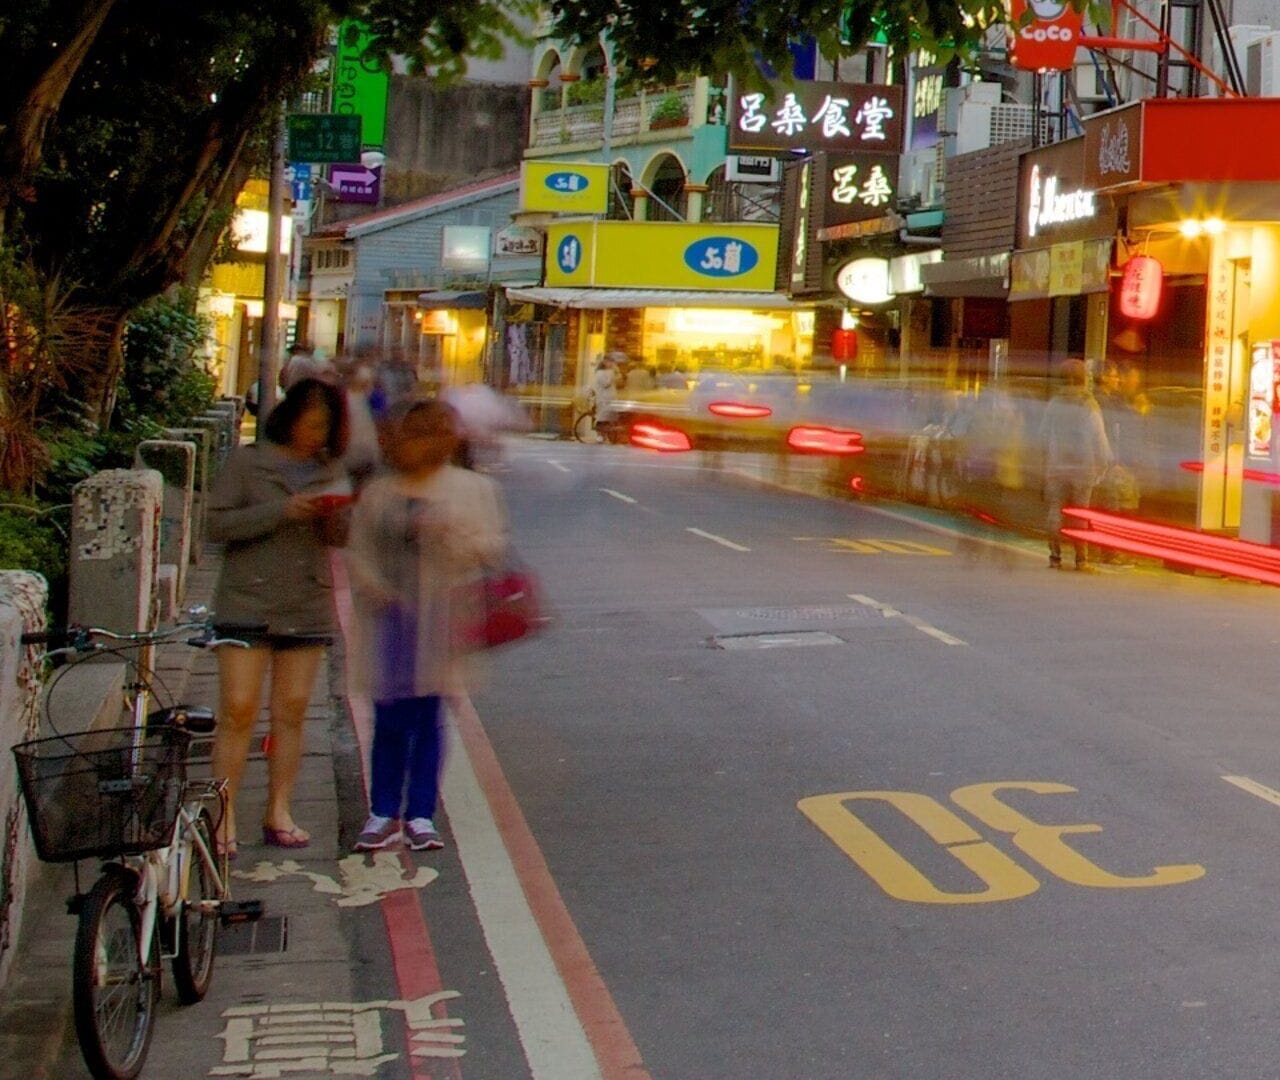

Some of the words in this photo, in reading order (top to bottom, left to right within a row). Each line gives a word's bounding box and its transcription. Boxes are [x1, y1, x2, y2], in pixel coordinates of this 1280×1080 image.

[740, 92, 893, 140] 呂桑食堂
[831, 165, 893, 207] 呂桑
[700, 240, 742, 273] 50嵐
